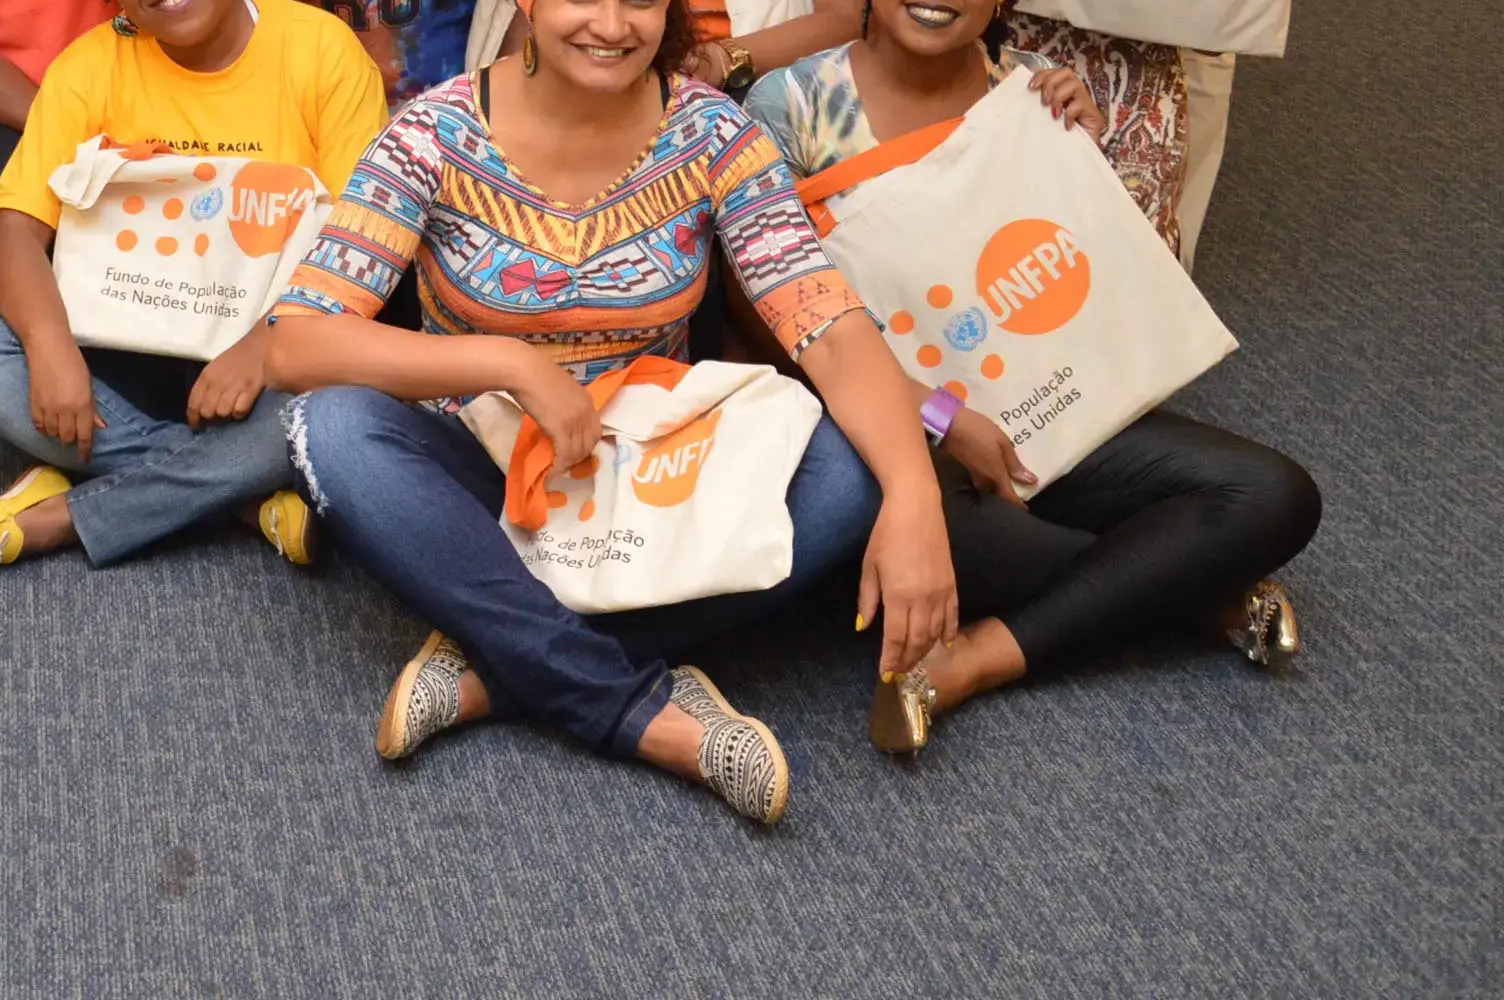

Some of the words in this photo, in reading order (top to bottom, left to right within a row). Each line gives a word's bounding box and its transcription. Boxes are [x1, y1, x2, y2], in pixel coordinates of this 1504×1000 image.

[218, 141, 263, 153] RACIAL
[104, 267, 150, 286] Fundo
[154, 277, 174, 290] de
[178, 281, 247, 301] População
[980, 229, 1080, 325] UNFPA
[100, 285, 127, 302] das
[132, 289, 188, 310] Nações
[193, 301, 239, 319] Unidas
[1000, 365, 1074, 426] População
[1030, 386, 1082, 430] Unidas
[536, 547, 584, 569] Nações
[558, 538, 576, 551] de
